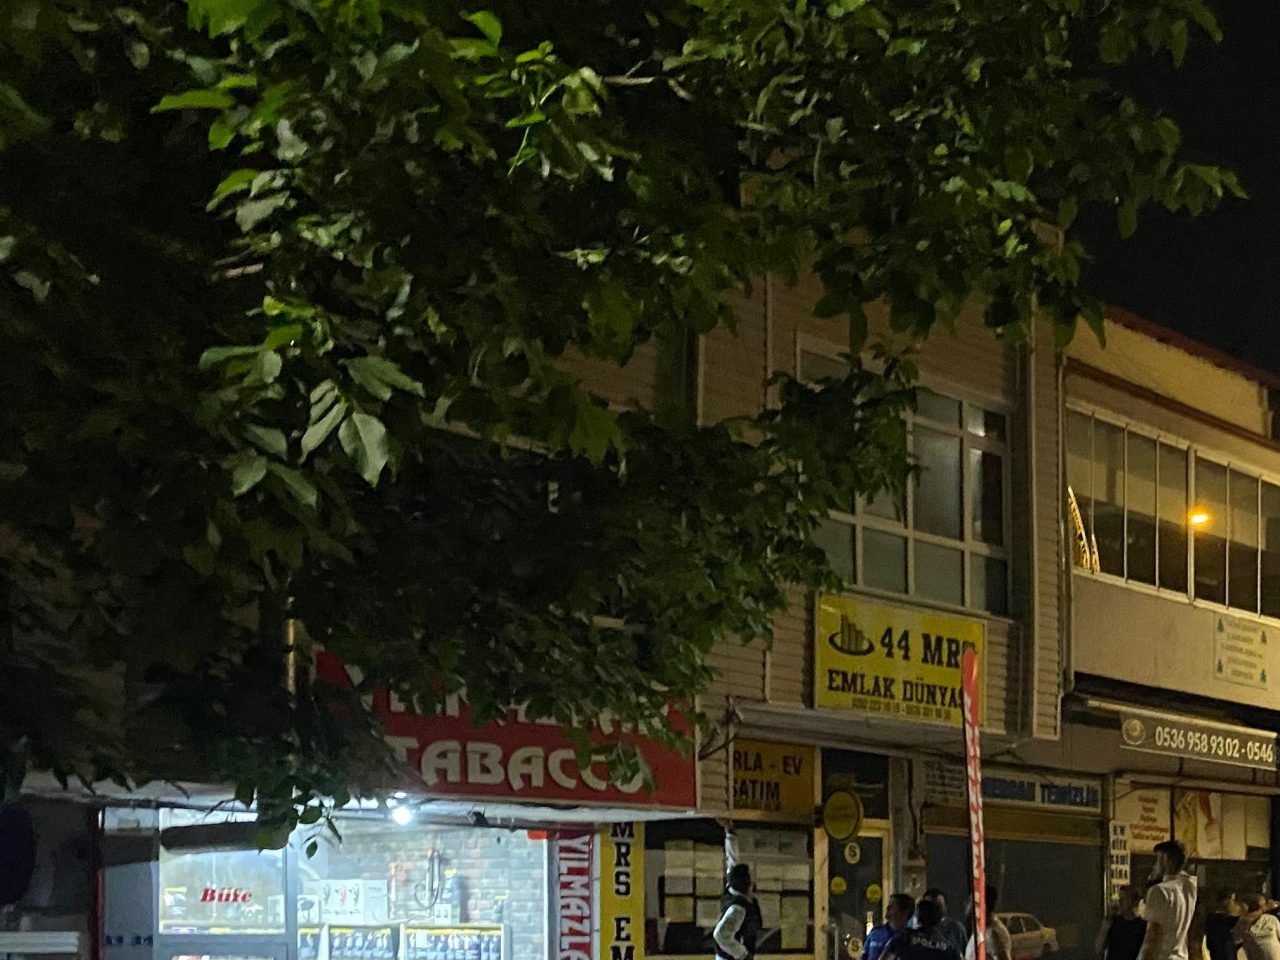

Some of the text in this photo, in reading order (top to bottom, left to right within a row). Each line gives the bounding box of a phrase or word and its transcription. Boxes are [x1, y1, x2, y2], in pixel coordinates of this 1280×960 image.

[879, 627, 976, 669] 44 MR
[827, 669, 896, 700] EMLAK
[902, 676, 965, 709] DÜNYA
[1155, 726, 1185, 750] 0536
[1187, 731, 1208, 753] 958
[782, 755, 803, 776] EV
[610, 822, 634, 896] MRS
[199, 886, 252, 904] Büfe
